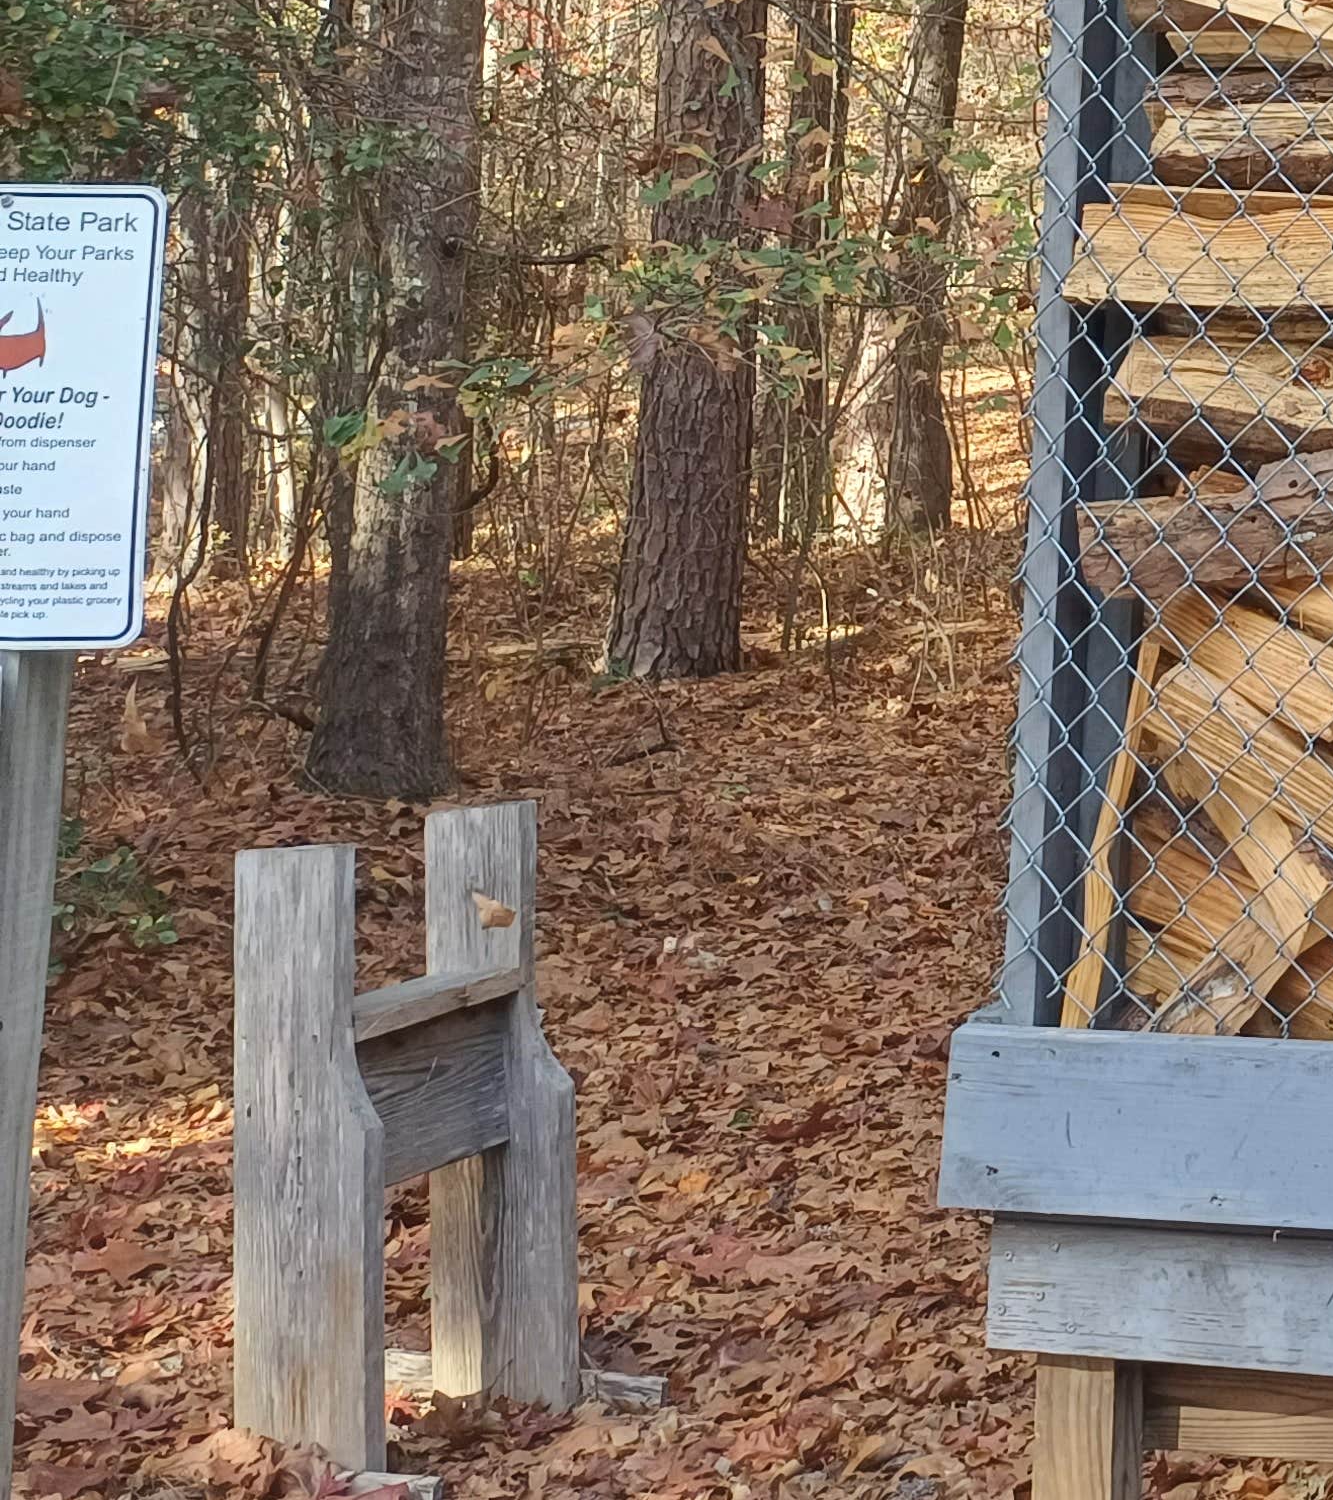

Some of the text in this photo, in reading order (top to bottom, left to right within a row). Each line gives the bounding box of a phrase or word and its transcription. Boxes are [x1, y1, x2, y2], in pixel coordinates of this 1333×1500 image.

[8, 211, 138, 232] State Park
[0, 245, 134, 263] eep Your Parks
[14, 268, 84, 286] Healthy
[13, 386, 55, 403] Your
[59, 387, 98, 408] Dog
[0, 412, 64, 429] oodie!
[30, 437, 96, 449] dispenser
[0, 460, 56, 471] our hand
[0, 485, 22, 494] ste
[3, 508, 69, 520] your hand
[10, 532, 35, 544] bag
[40, 532, 65, 541] and
[69, 532, 121, 543] dispose
[19, 568, 55, 577] healthy
[58, 568, 69, 577] by
[72, 568, 106, 577] picking
[108, 569, 120, 577] up
[1, 582, 37, 590] streams
[28, 598, 49, 606] your
[52, 596, 83, 606] plastic
[86, 597, 122, 606] grocery
[11, 611, 29, 619] pick
